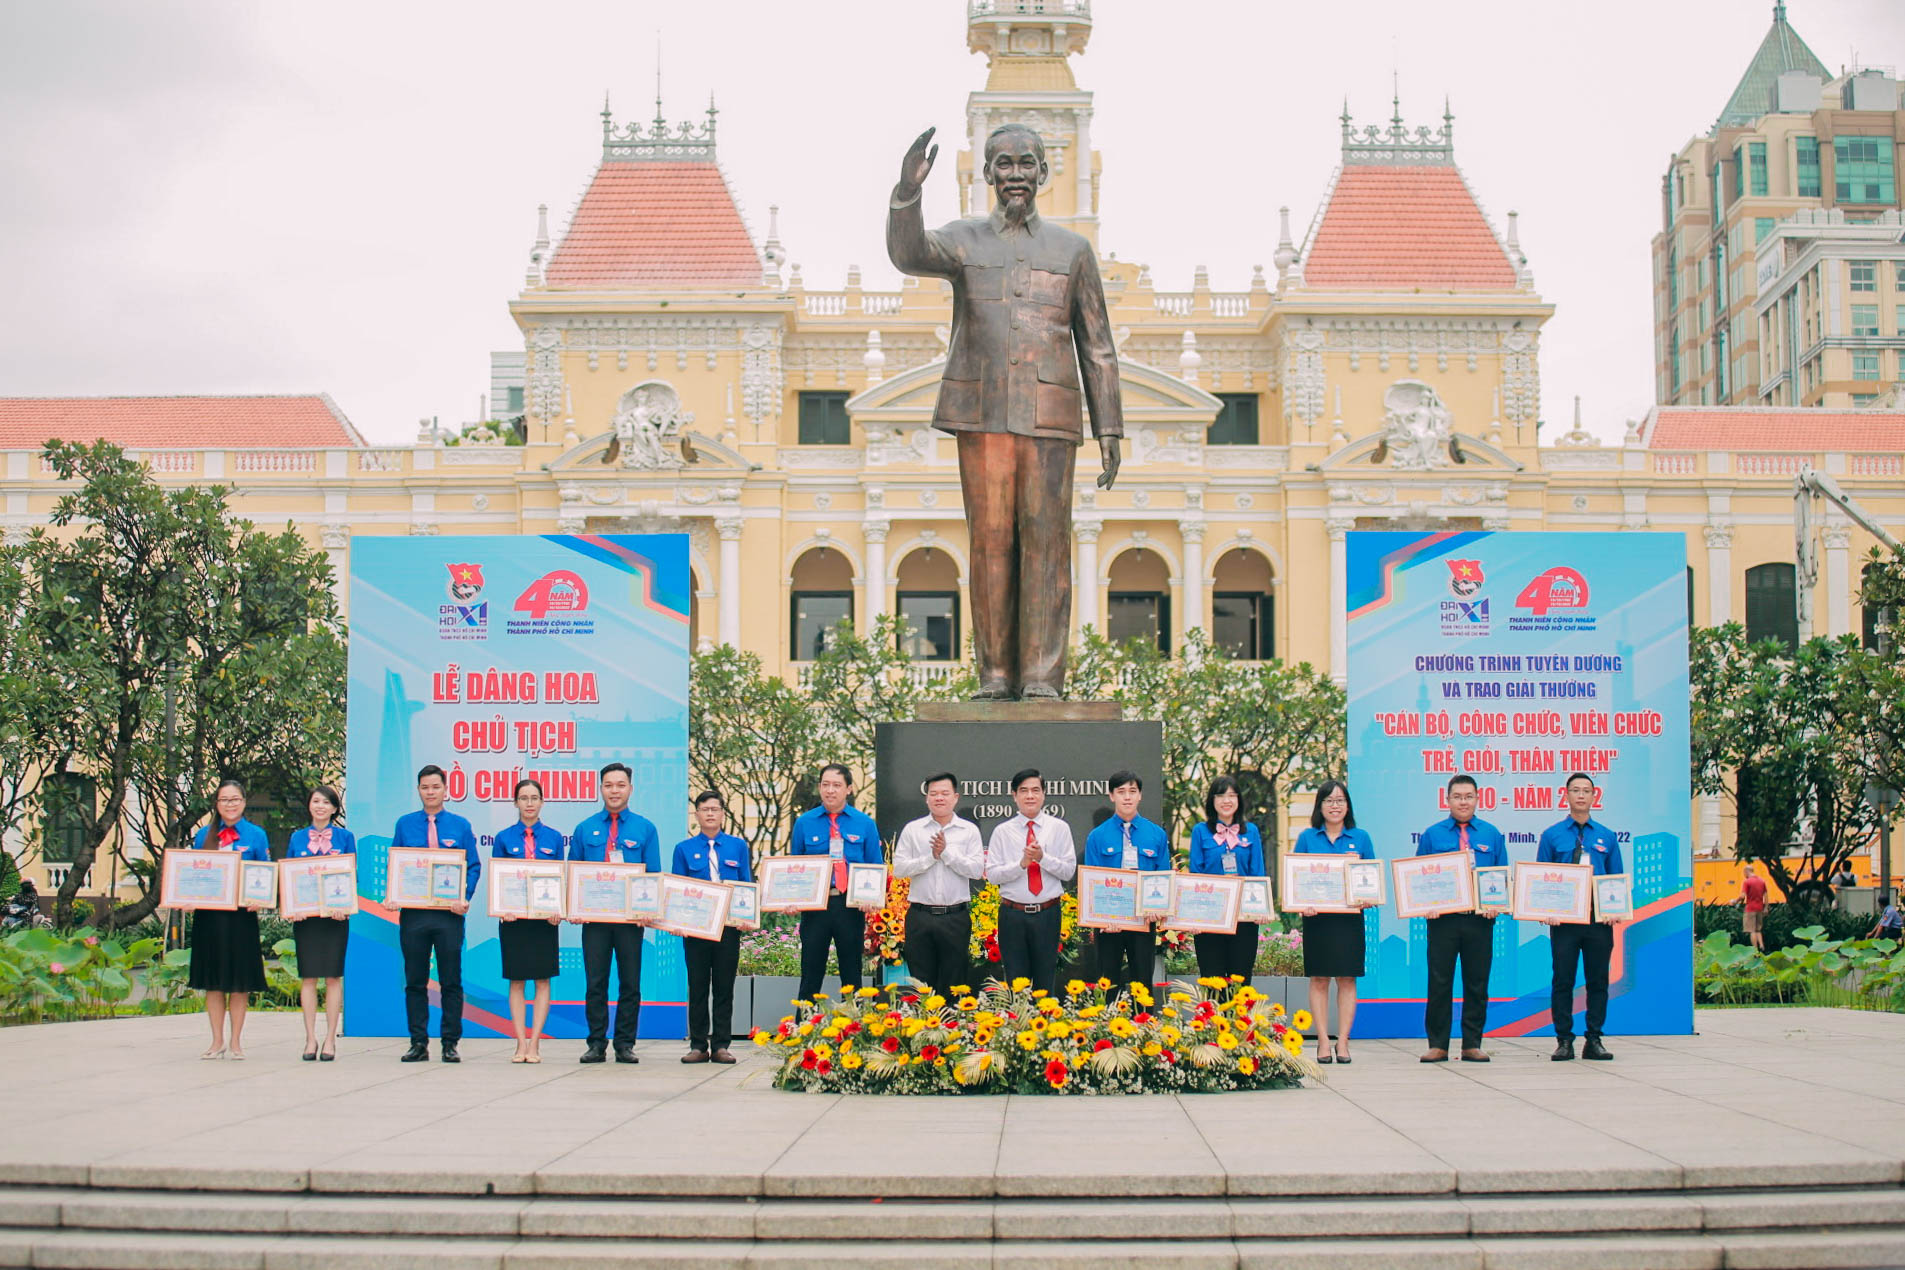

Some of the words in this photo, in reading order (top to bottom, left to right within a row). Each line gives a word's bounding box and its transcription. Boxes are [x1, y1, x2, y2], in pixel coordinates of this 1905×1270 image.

[1415, 653, 1474, 672] CHƯƠNG
[1526, 653, 1569, 672] TUYÊN
[1573, 653, 1622, 672] DƯƠNG
[433, 664, 460, 703] LỄ
[466, 667, 537, 703] DÂNG
[545, 672, 599, 703] HOA
[1442, 680, 1461, 698] VÀ
[1465, 682, 1501, 698] TRAO
[1539, 679, 1597, 699] THƯỞNG
[453, 714, 507, 752] CHỦ
[514, 721, 577, 757] TỊCH
[1375, 709, 1420, 736] "CÁN
[1425, 709, 1454, 740] BỘ,
[1459, 709, 1507, 736] CÔNG
[1512, 710, 1565, 739] CHỨC,
[1569, 709, 1609, 736] VIÊN
[1614, 710, 1663, 736] CHỨC
[1422, 744, 1458, 773] TRẺ,
[1463, 744, 1504, 773] GIỎI,
[1508, 747, 1554, 772] THÂN
[1559, 749, 1618, 776] THIỆN"
[475, 766, 523, 802] CHÍ
[528, 770, 599, 802] MINH
[961, 780, 1002, 798] TỊCH
[1044, 777, 1065, 795] HÍ
[1477, 786, 1496, 810] 10
[1513, 783, 1553, 810] NĂM
[1558, 786, 1603, 810] 22
[973, 804, 1012, 819] (1890
[1042, 804, 1065, 818] 69)
[481, 835, 493, 846] Ch
[1508, 832, 1537, 844] Minh,
